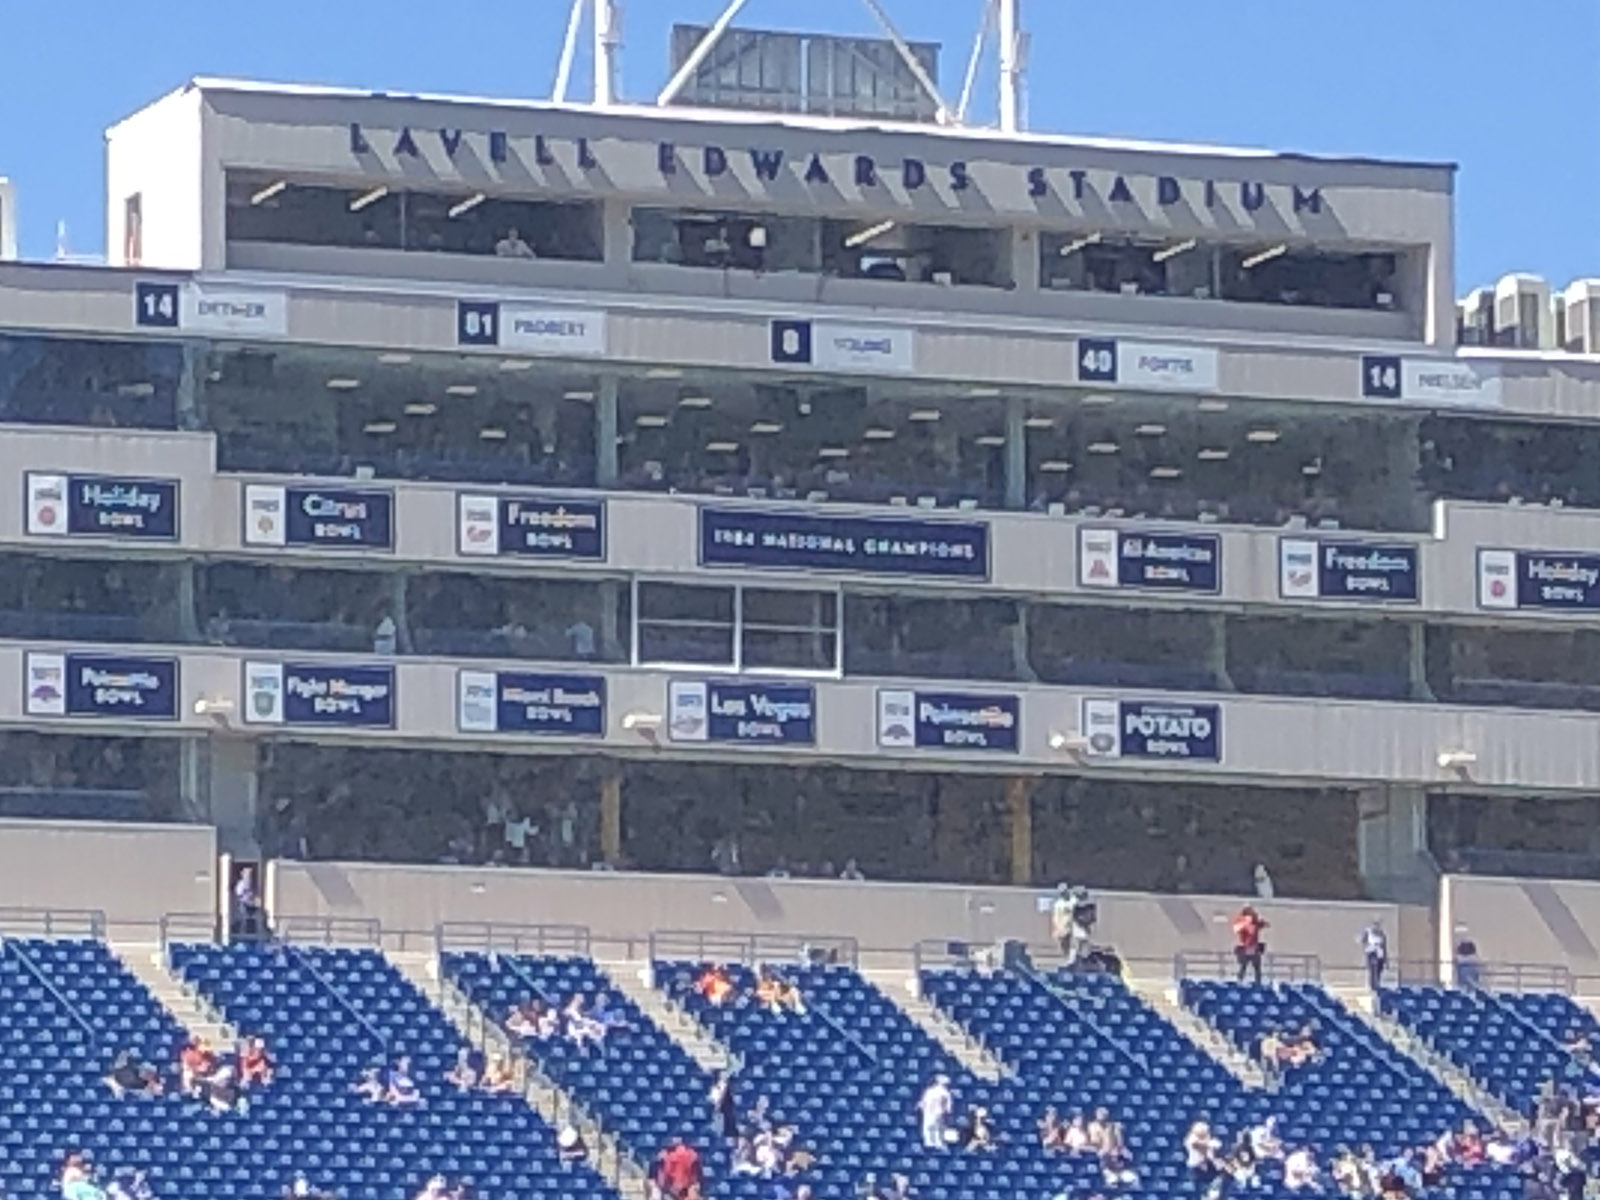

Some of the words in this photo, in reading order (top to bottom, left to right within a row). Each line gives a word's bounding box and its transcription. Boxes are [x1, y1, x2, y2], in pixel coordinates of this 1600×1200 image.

[350, 123, 598, 168] LAVELL
[657, 142, 968, 190] EDWARDS
[1027, 167, 1322, 214] STADIUM
[144, 293, 173, 318] 14
[83, 485, 160, 512] Holiday
[508, 503, 596, 529] Freedom
[1326, 548, 1409, 572] Freedom
[1528, 559, 1599, 587] Holiday
[750, 693, 811, 722] Vegas
[1125, 713, 1211, 739] POTATO
